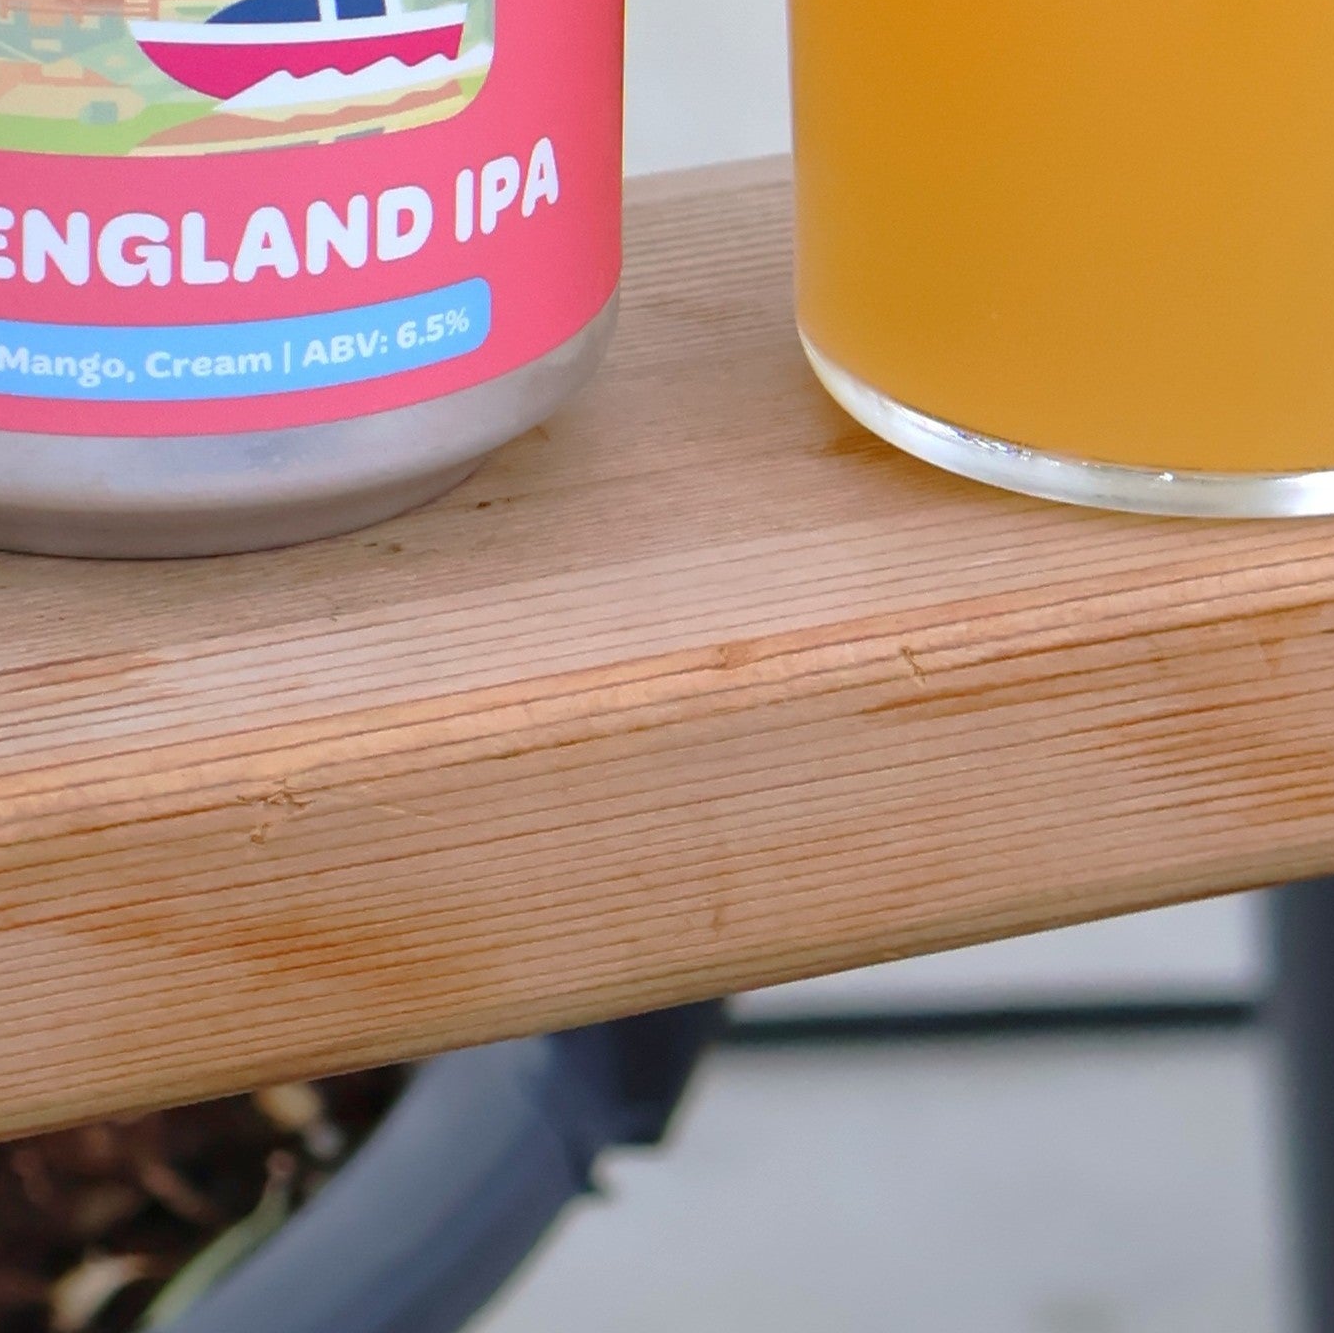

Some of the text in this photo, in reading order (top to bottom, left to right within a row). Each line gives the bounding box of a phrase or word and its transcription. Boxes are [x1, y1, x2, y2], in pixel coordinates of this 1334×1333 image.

[453, 137, 561, 244] IPA
[144, 344, 273, 381] Cream
[301, 330, 390, 370] ABV:
[395, 306, 471, 351] 6.5%
